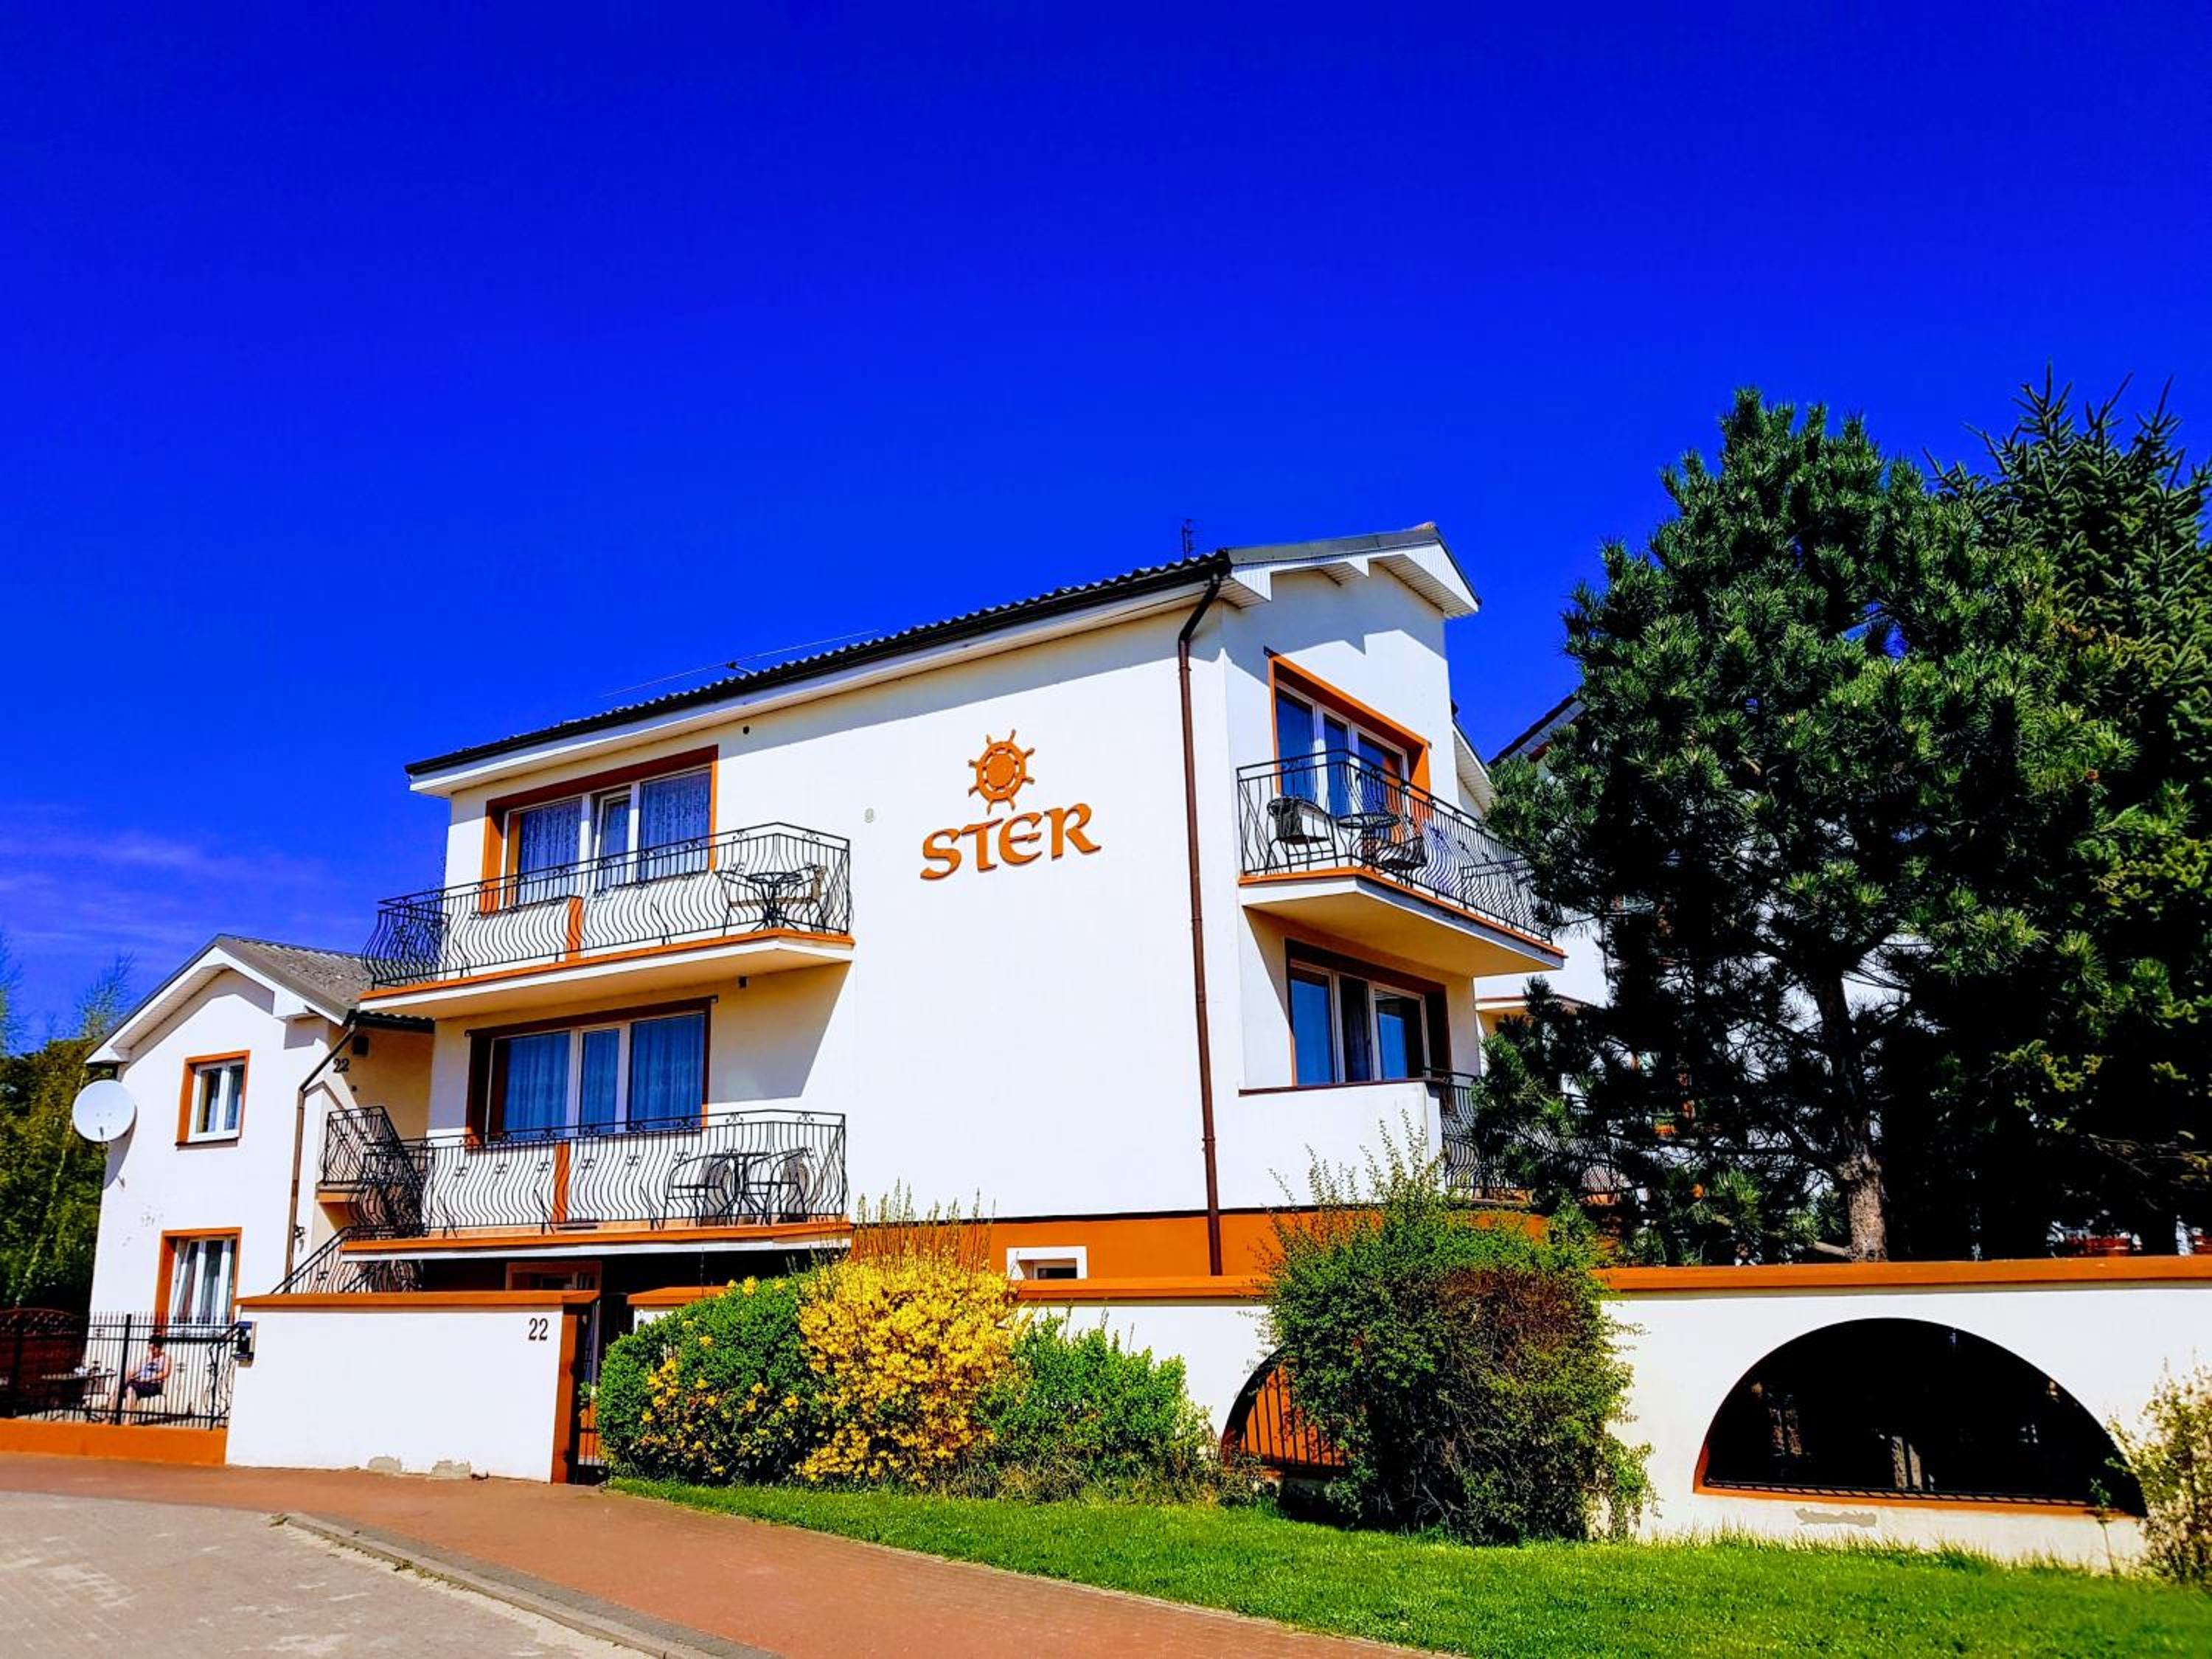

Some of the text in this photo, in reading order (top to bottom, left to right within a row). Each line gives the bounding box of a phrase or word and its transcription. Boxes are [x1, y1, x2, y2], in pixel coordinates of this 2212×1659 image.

[920, 803, 1102, 881] STER
[333, 1057, 349, 1074] 22
[528, 1317, 548, 1341] 22
